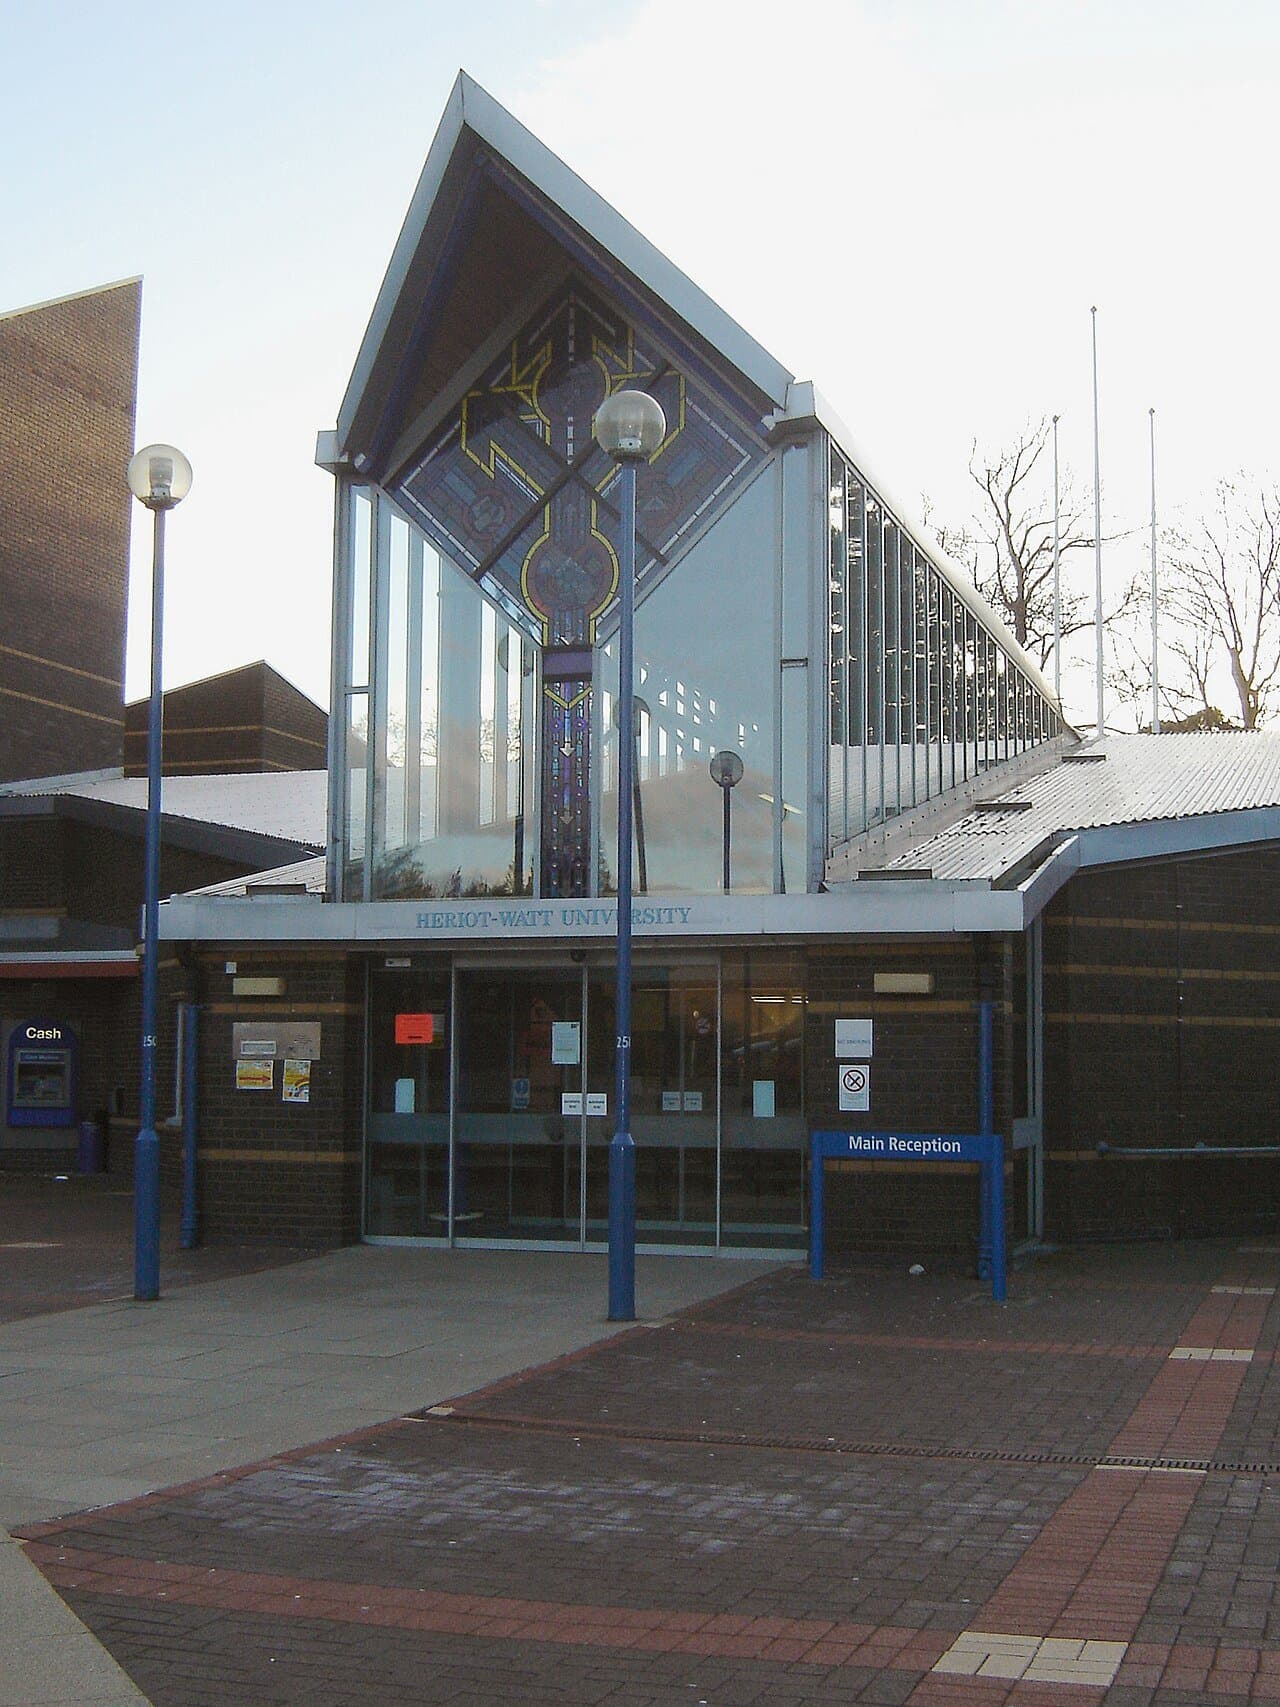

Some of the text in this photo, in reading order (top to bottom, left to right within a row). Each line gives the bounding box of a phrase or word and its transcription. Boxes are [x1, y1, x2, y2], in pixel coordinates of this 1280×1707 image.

[415, 907, 692, 929] HERIOT-WATT UNIVRSITY
[25, 1027, 62, 1040] Cash
[848, 1135, 961, 1156] Main Reception
